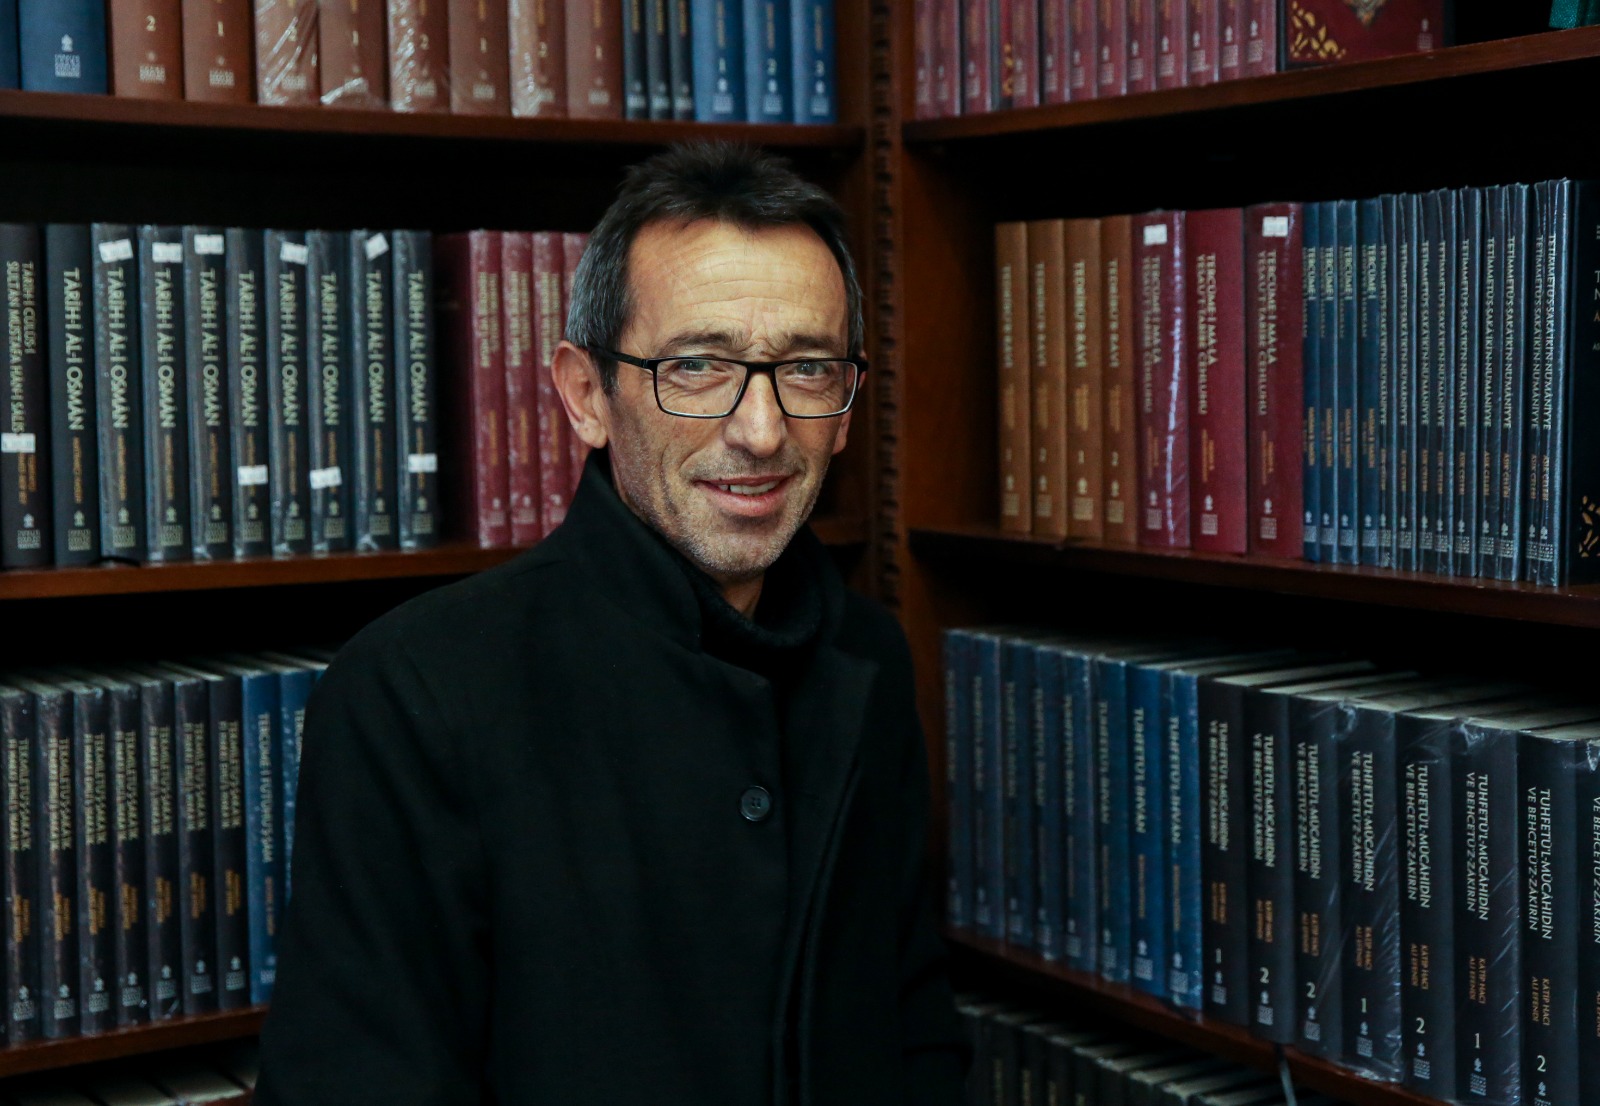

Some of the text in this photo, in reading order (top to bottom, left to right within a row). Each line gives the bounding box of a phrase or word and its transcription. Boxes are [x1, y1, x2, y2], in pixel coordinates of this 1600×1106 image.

[146, 15, 156, 31] 2
[1351, 751, 1362, 765] VE
[1405, 764, 1416, 779] VE
[1466, 772, 1476, 787] VE
[1528, 787, 1538, 802] VE
[1260, 966, 1269, 984] 2
[1306, 982, 1316, 998] 2
[1360, 998, 1367, 1014] 1
[1416, 1017, 1426, 1034] 2
[1475, 1033, 1481, 1049] 1
[1537, 1055, 1547, 1073] 2
